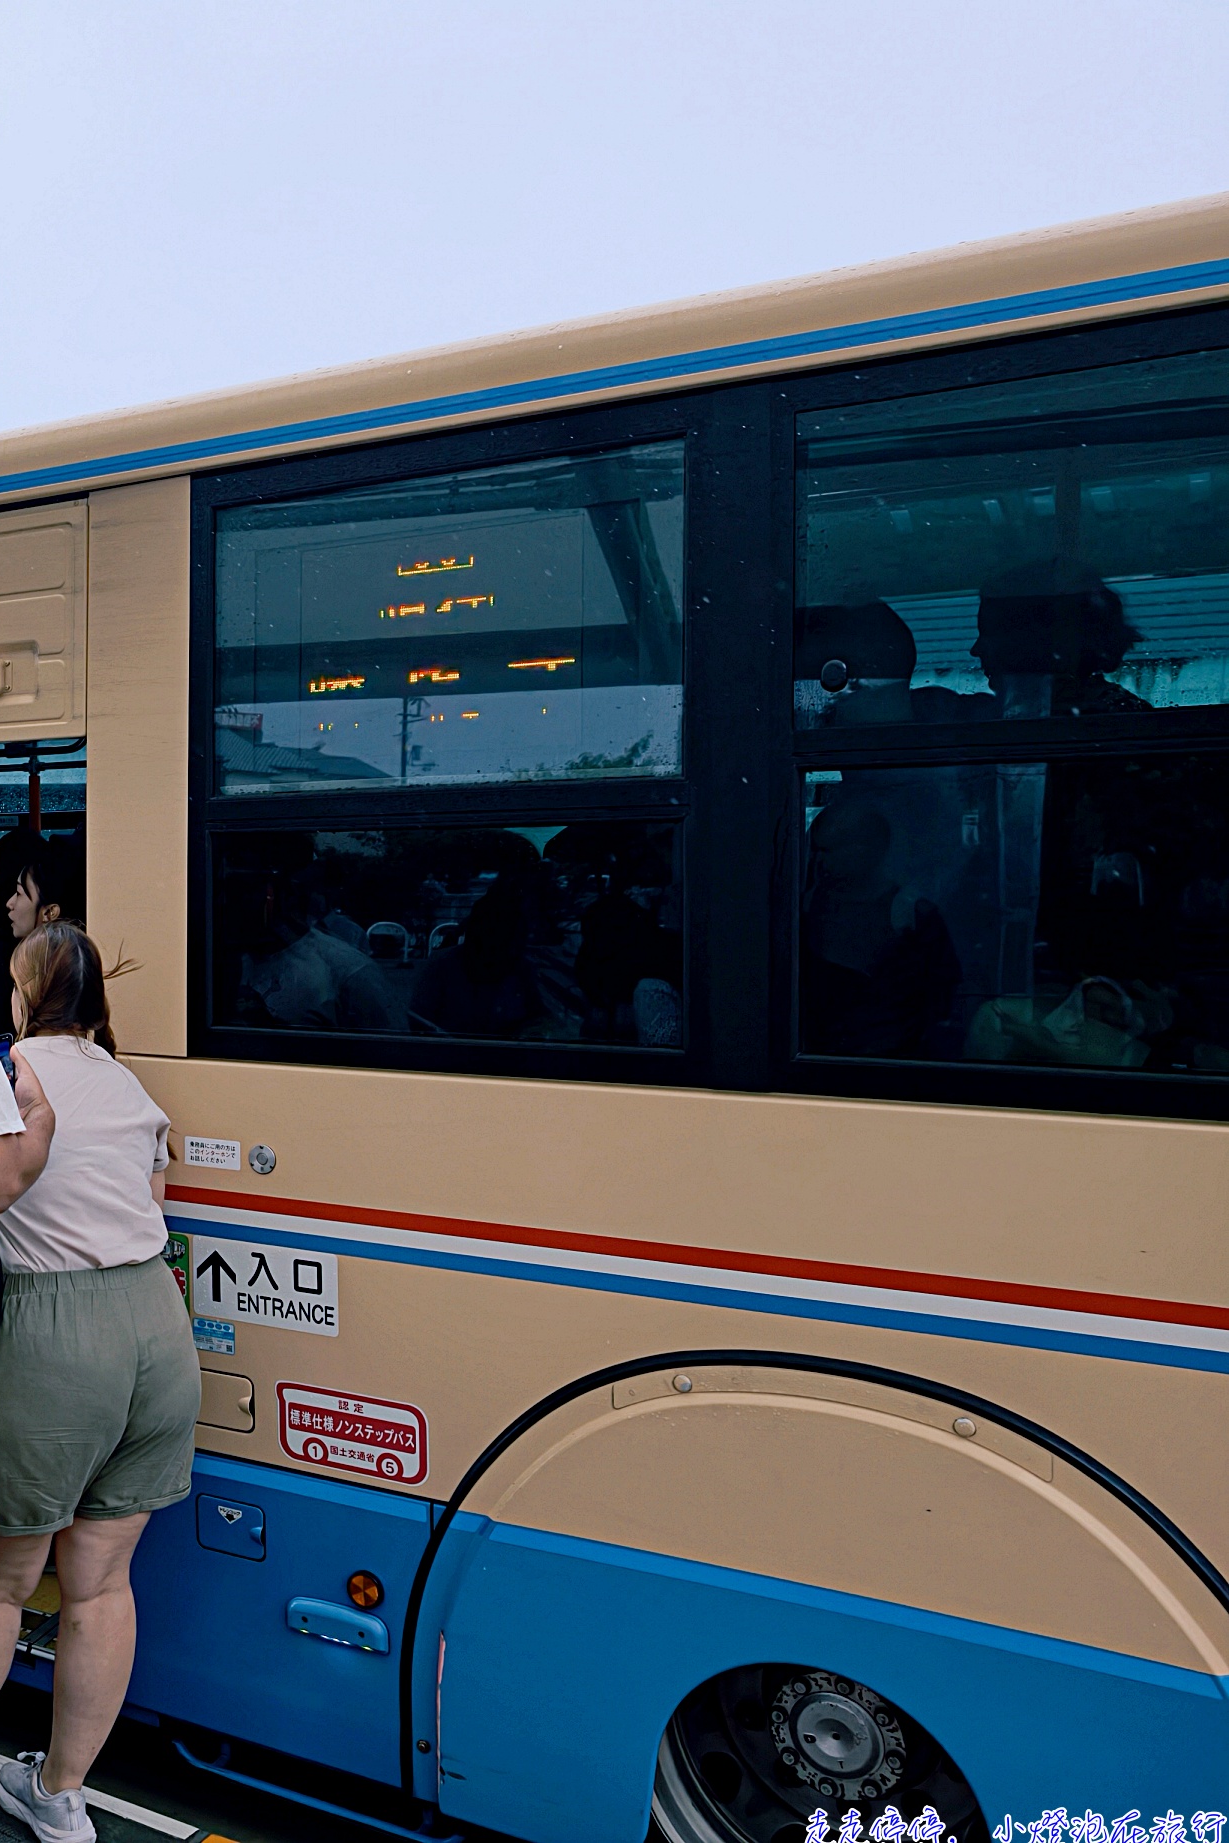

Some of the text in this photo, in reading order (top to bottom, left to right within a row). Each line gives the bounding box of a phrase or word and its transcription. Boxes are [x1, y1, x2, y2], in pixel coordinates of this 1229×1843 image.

[246, 1251, 323, 1295] 入口
[236, 1291, 336, 1327] ENTRANCE
[289, 1408, 415, 1449] 標準仕様ノンステップバス
[329, 1445, 376, 1463] 国土交通省
